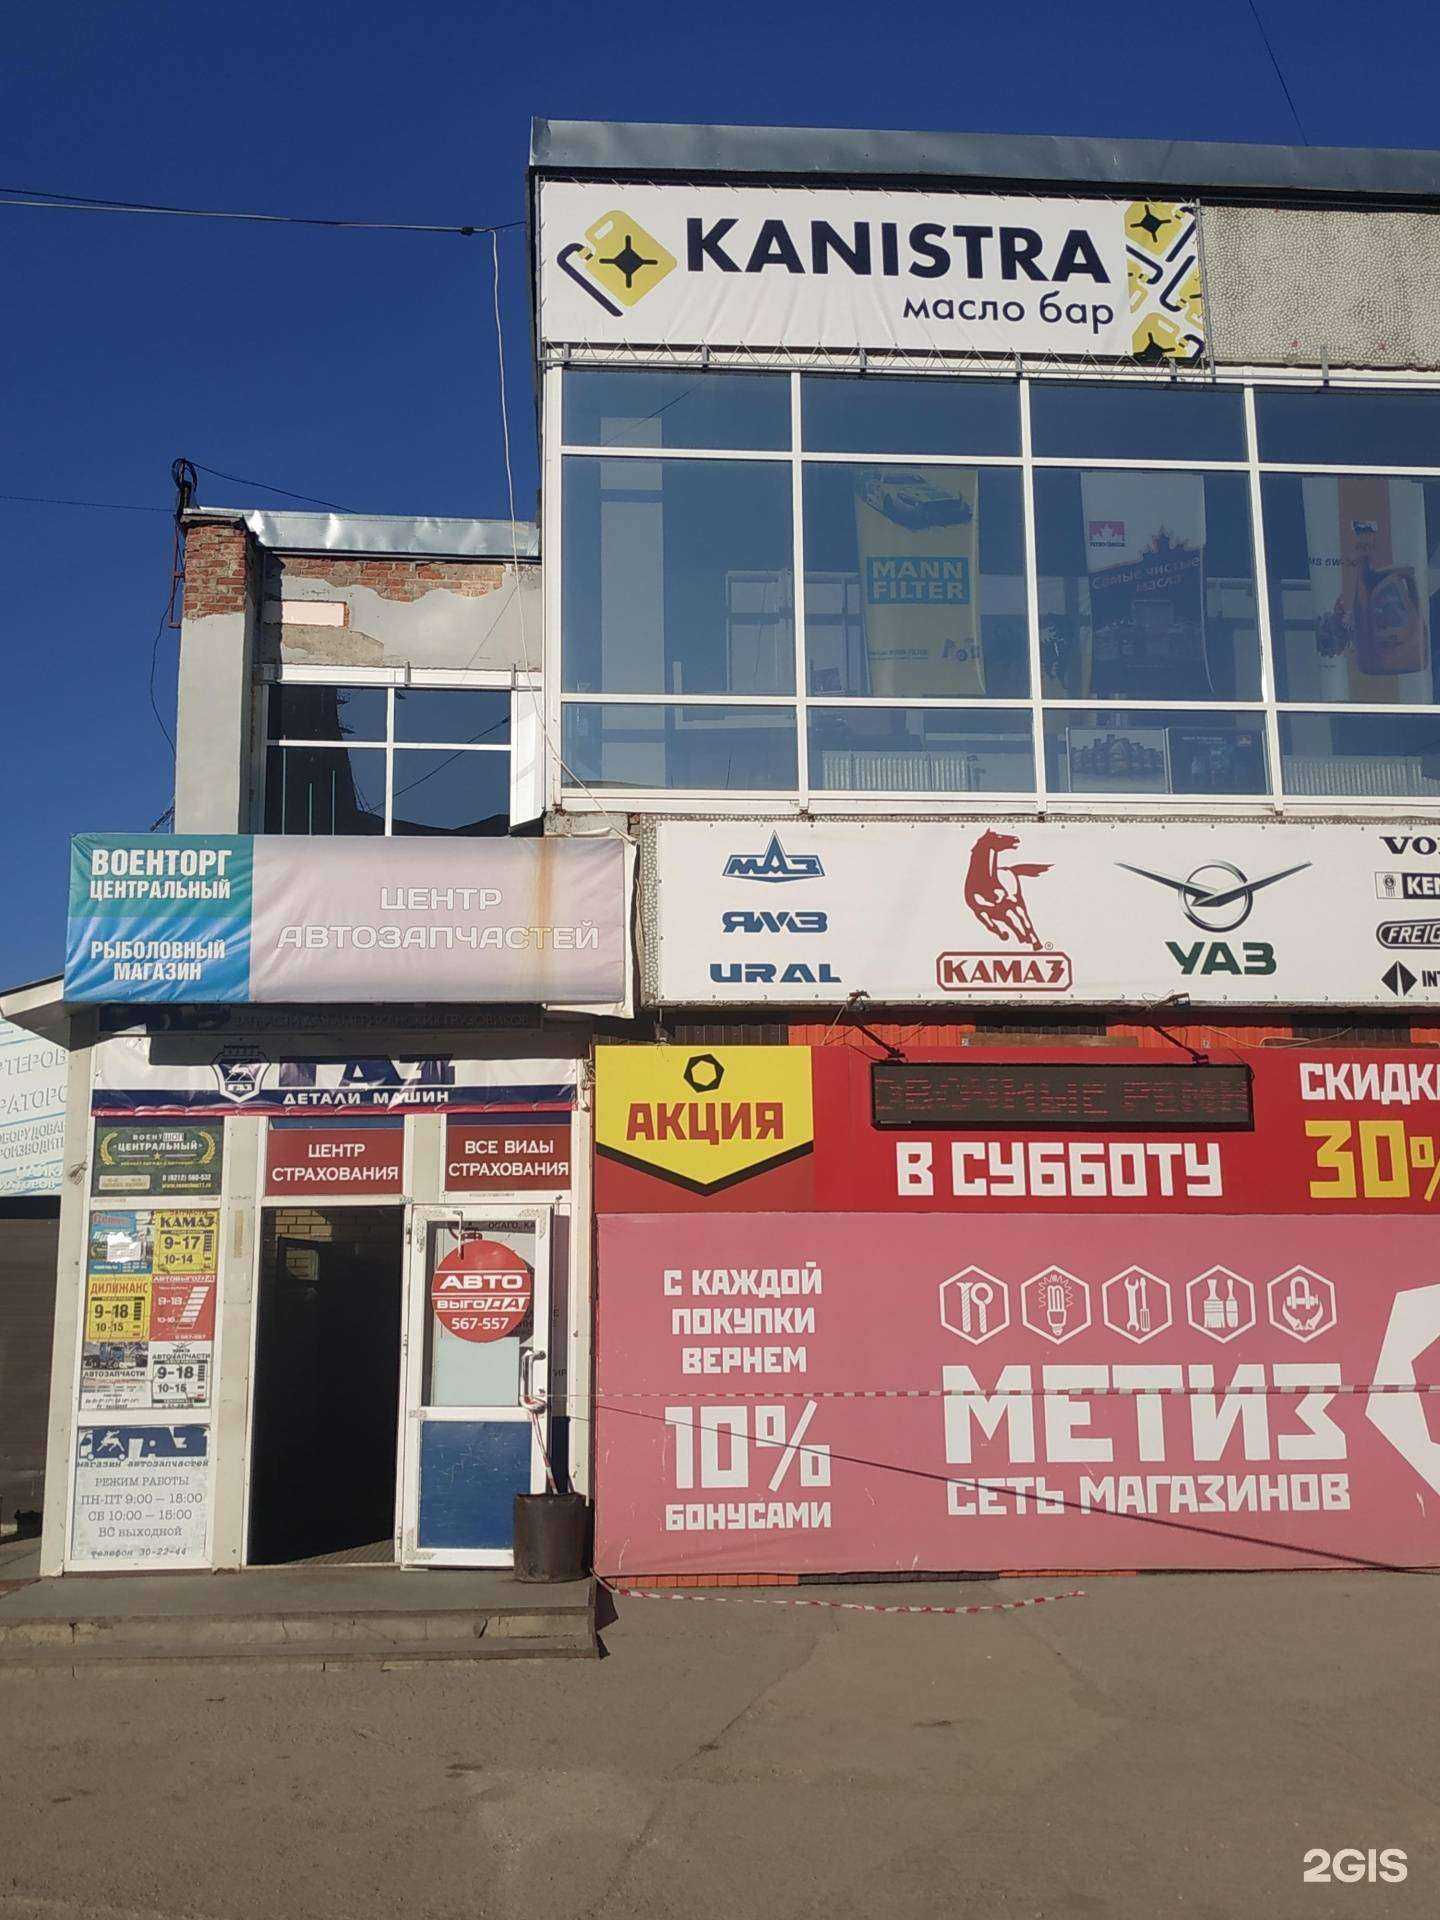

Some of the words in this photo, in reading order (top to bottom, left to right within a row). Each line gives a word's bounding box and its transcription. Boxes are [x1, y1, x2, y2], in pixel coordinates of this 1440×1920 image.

[686, 217, 1110, 284] KANISTRA
[902, 297, 1024, 323] масло
[1040, 292, 1113, 334] бар
[872, 560, 963, 578] MANN
[873, 582, 966, 600] FILTER
[1383, 837, 1440, 855] VO
[91, 849, 232, 876] ВОЕНТОРГ
[90, 878, 230, 901] ЦЕНТРАЛЬНЫЙ
[381, 888, 502, 911] ЦЕНТР
[277, 921, 598, 950] АВТОЗАПЧАСТЕЙ
[91, 940, 225, 960] РЫБОЛОВНЫЙ
[1165, 941, 1277, 975] УАЗ
[114, 963, 201, 981] МАГАЗИН
[710, 964, 842, 983] URAL
[943, 960, 1065, 983] КАМАЗ
[1299, 1062, 1440, 1105] СКИДК
[283, 1092, 360, 1104] ДЕТАЛИ
[373, 1091, 449, 1104] МАШИН
[628, 1102, 784, 1144] АКЦИЯ
[308, 1144, 366, 1158] ЦЕНТР
[465, 1141, 498, 1155] ВСЕ
[504, 1140, 555, 1156] ВИДЫ
[271, 1165, 399, 1182] СТРАХОВАНИЯ
[448, 1161, 569, 1178] СТРАХОВАНИЯ
[897, 1143, 933, 1196] В
[952, 1143, 1223, 1197] СУББОТУ
[160, 1216, 214, 1227] КАМАЗ
[164, 1236, 200, 1249] 9-17
[164, 1255, 193, 1264] 10-14
[440, 1275, 523, 1290] АВТО
[664, 1270, 682, 1295] С
[691, 1262, 822, 1296] КАЖДОЙ
[90, 1283, 148, 1294] ДИЛИЖАНС
[94, 1305, 129, 1318] 9-18
[95, 1323, 124, 1332] 10-15
[451, 1317, 509, 1330] 567-557
[671, 1307, 816, 1335] ПОКУПКИ
[682, 1347, 808, 1374] ВЕРНЕМ
[157, 1366, 194, 1379] 9-18
[942, 1363, 1348, 1464] МЕТИЗ
[664, 1400, 832, 1492] 10%
[95, 1477, 139, 1487] РЕЖИМ
[143, 1477, 189, 1486] РАБОТЫ
[81, 1495, 122, 1505] ПН-ПТ
[125, 1494, 153, 1504] 9:00
[169, 1493, 203, 1503] 18:00
[947, 1479, 1065, 1516] СЕТЬ
[1080, 1473, 1351, 1515] МАГАЗИНОВ
[88, 1511, 105, 1521] СБ
[109, 1511, 142, 1521] 10:00
[665, 1502, 832, 1531] БОНУСАМИ
[98, 1527, 115, 1537] ВС
[118, 1526, 182, 1538] выходной
